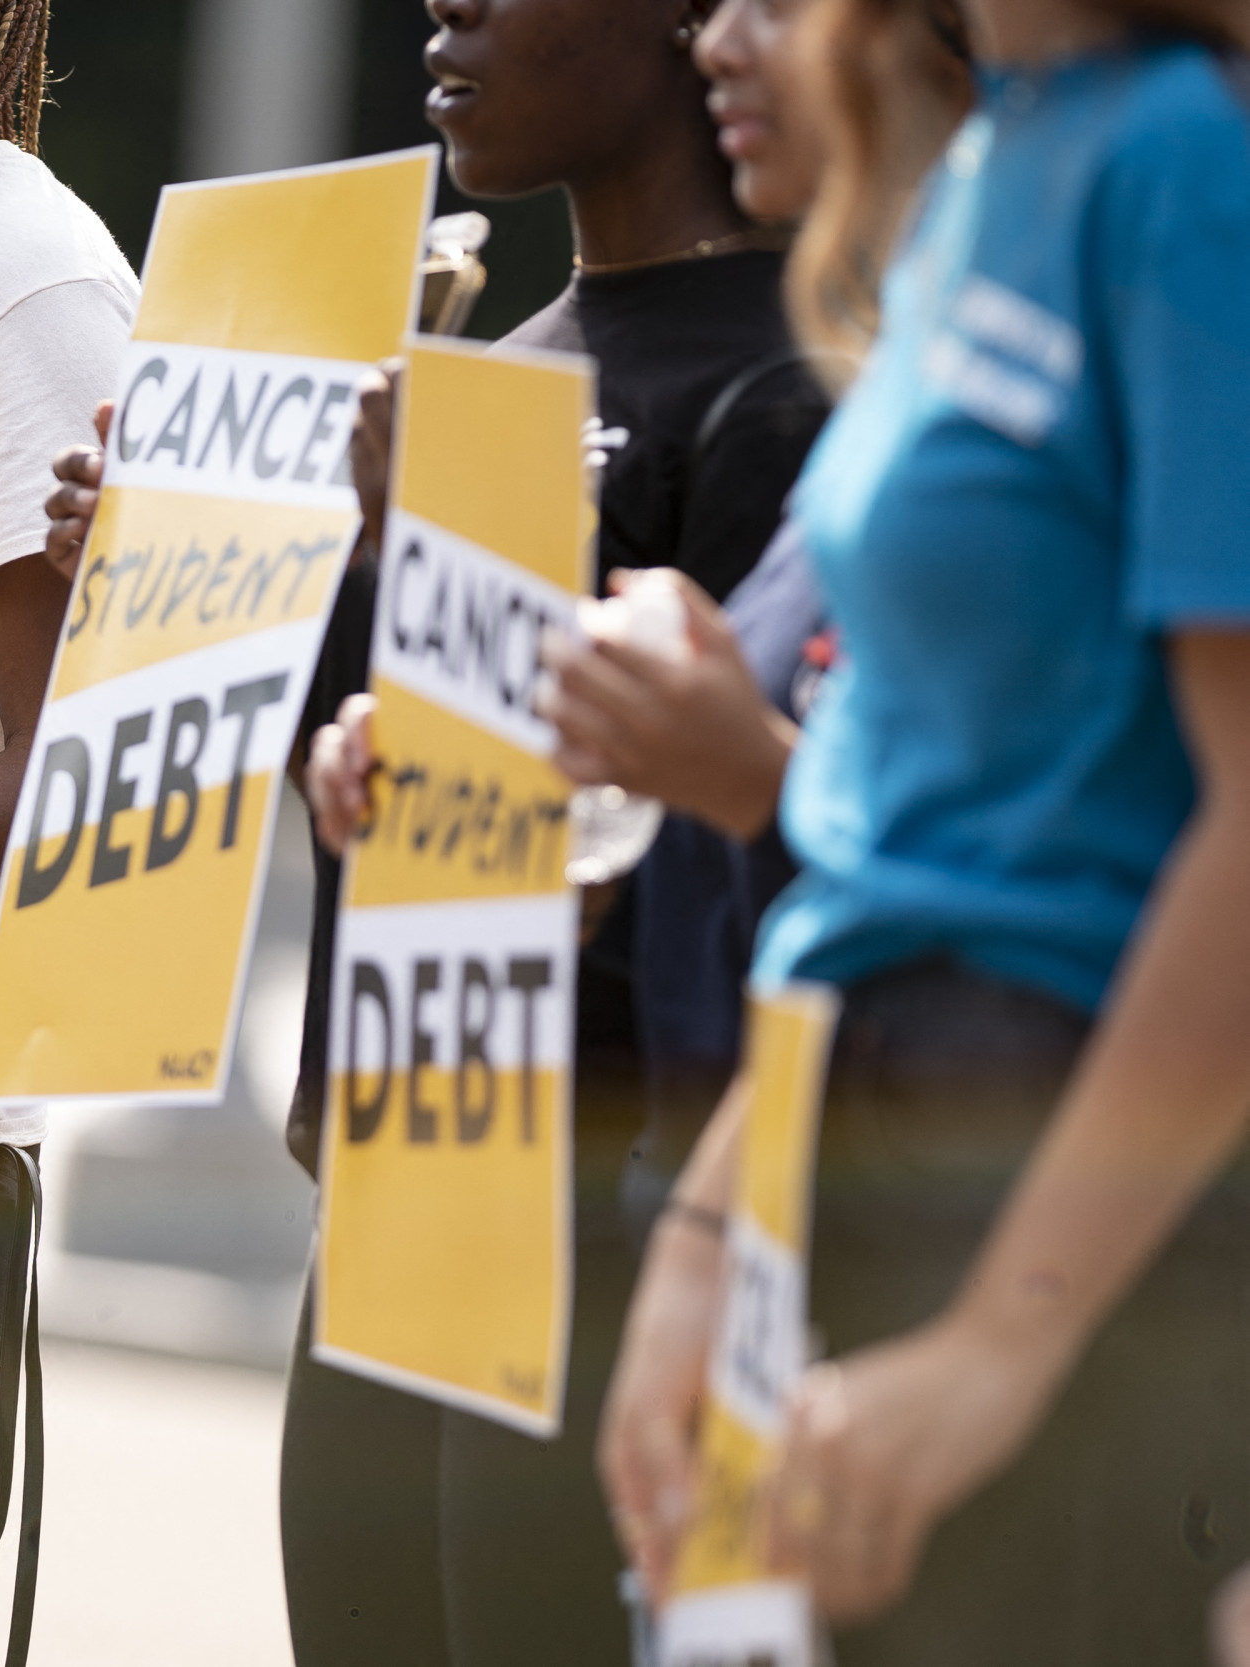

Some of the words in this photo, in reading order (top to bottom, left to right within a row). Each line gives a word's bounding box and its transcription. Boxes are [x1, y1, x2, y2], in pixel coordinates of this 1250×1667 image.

[67, 534, 342, 642] STUDENT
[15, 670, 293, 909] DEBT
[345, 952, 553, 1149] DEBT
